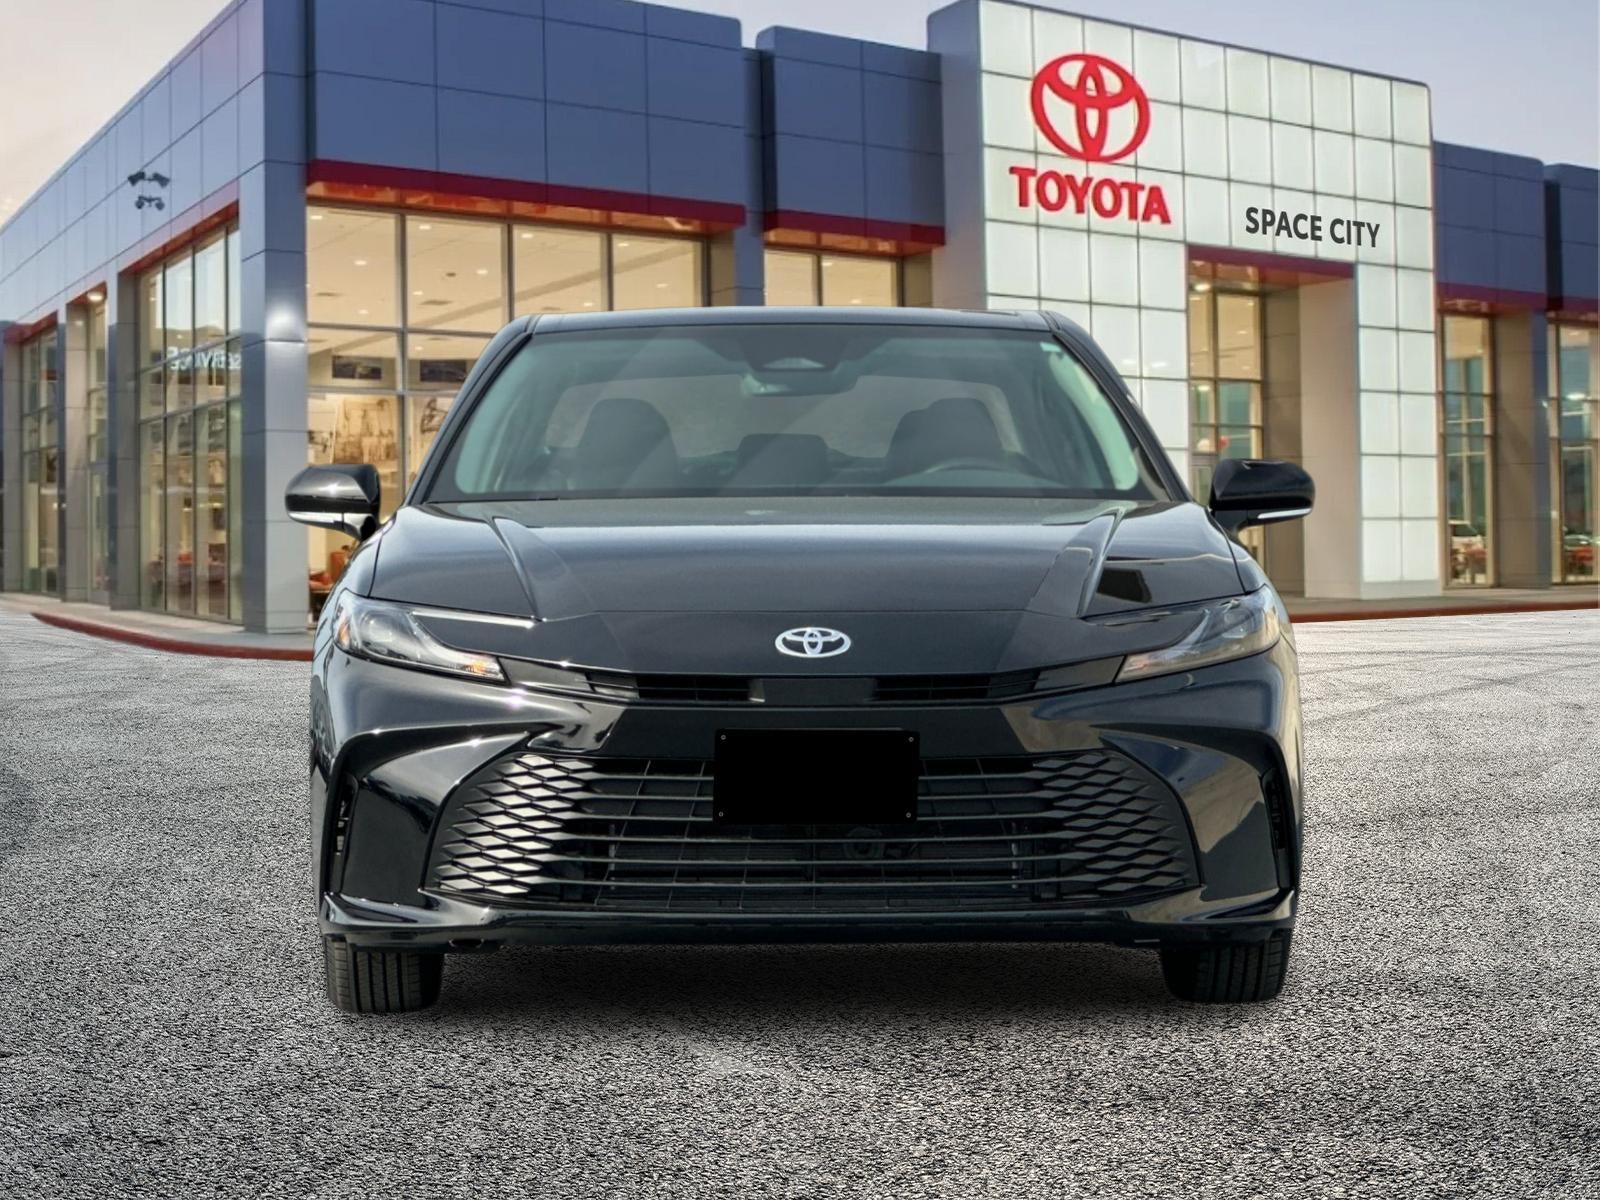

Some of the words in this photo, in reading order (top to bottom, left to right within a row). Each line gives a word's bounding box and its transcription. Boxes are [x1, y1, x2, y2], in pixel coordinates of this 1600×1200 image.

[1009, 166, 1171, 224] TOYOTA
[1245, 207, 1323, 242] SPACE
[1329, 218, 1381, 248] CITY
